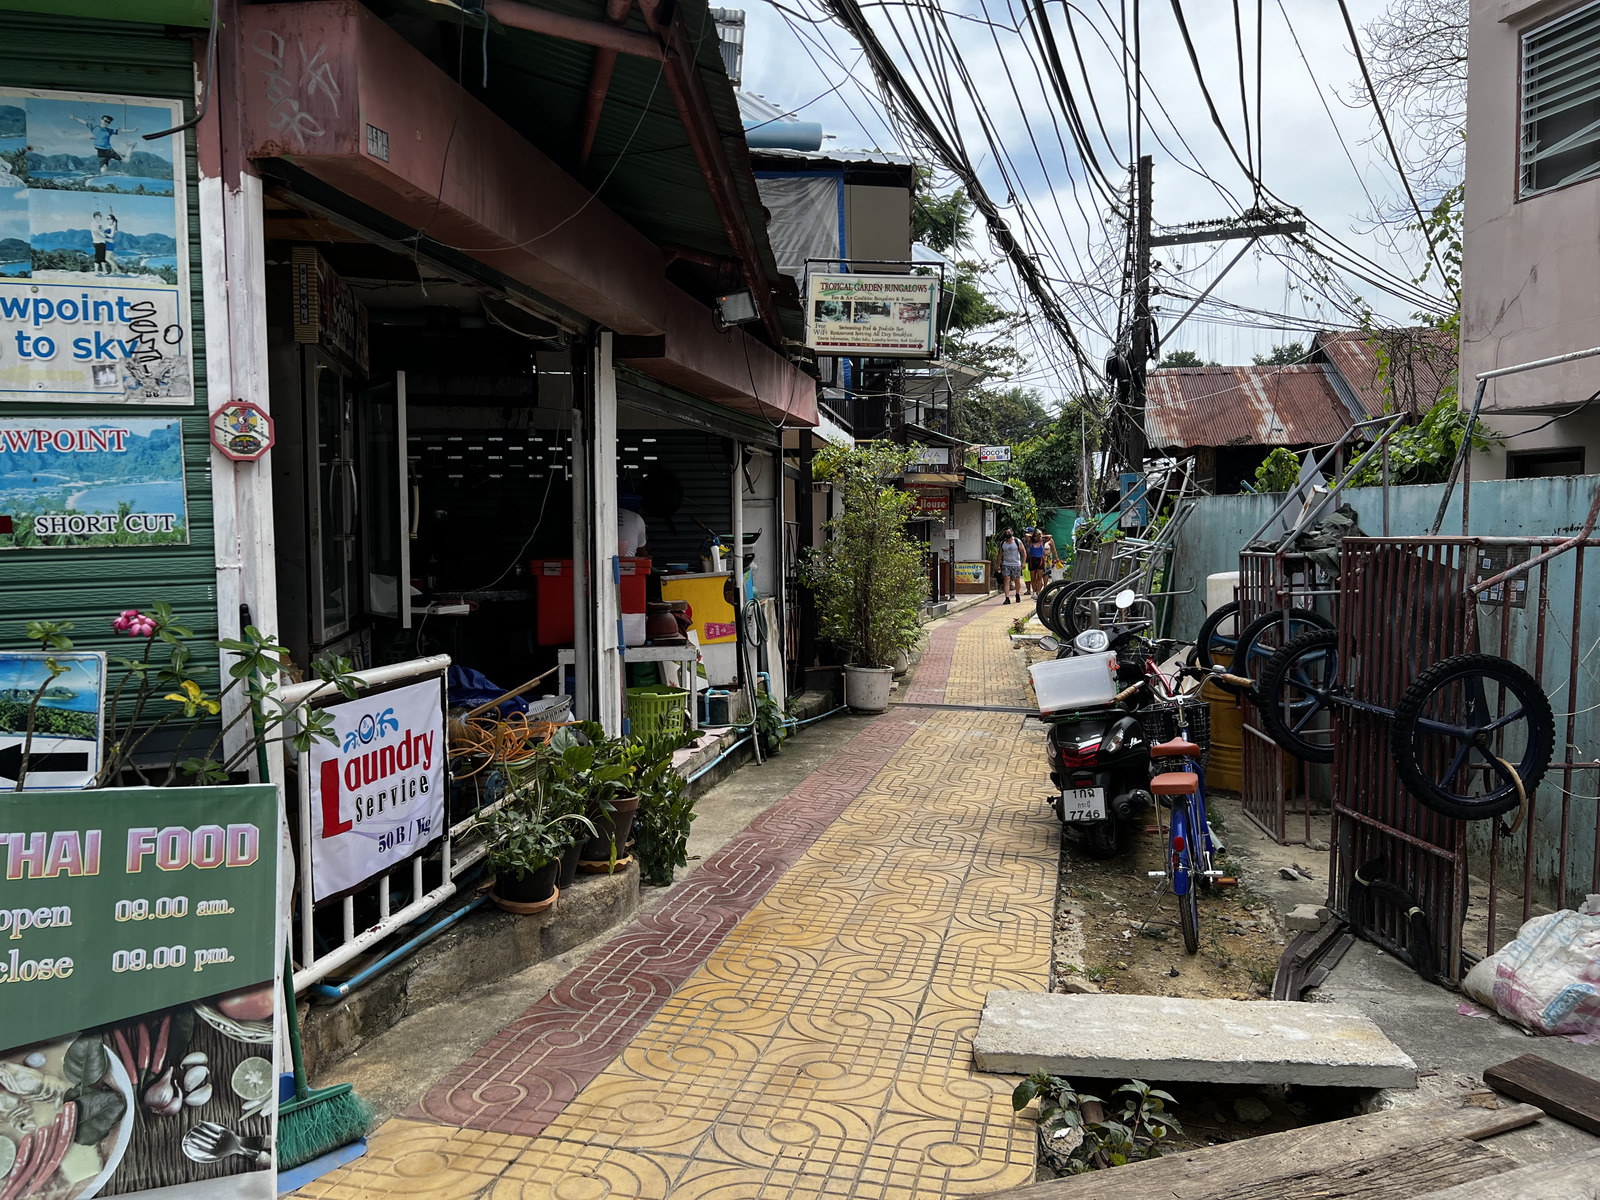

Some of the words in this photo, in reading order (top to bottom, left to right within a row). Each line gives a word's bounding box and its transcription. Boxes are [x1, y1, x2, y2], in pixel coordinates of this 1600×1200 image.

[820, 282, 853, 291] TROPICAL
[854, 283, 884, 292] GARDEN
[884, 284, 928, 293] BUNGALOWS
[15, 330, 56, 358] to
[36, 515, 118, 534] SHORT
[126, 514, 175, 532] CUT
[321, 729, 434, 839] Laundry
[355, 774, 430, 824] Service
[1070, 810, 1100, 820] 7746
[126, 823, 259, 873] FOOD
[0, 905, 72, 939] open
[115, 896, 188, 922] 09.00
[196, 898, 235, 916] am.
[112, 945, 186, 972] 09.00
[194, 947, 235, 972] pm.
